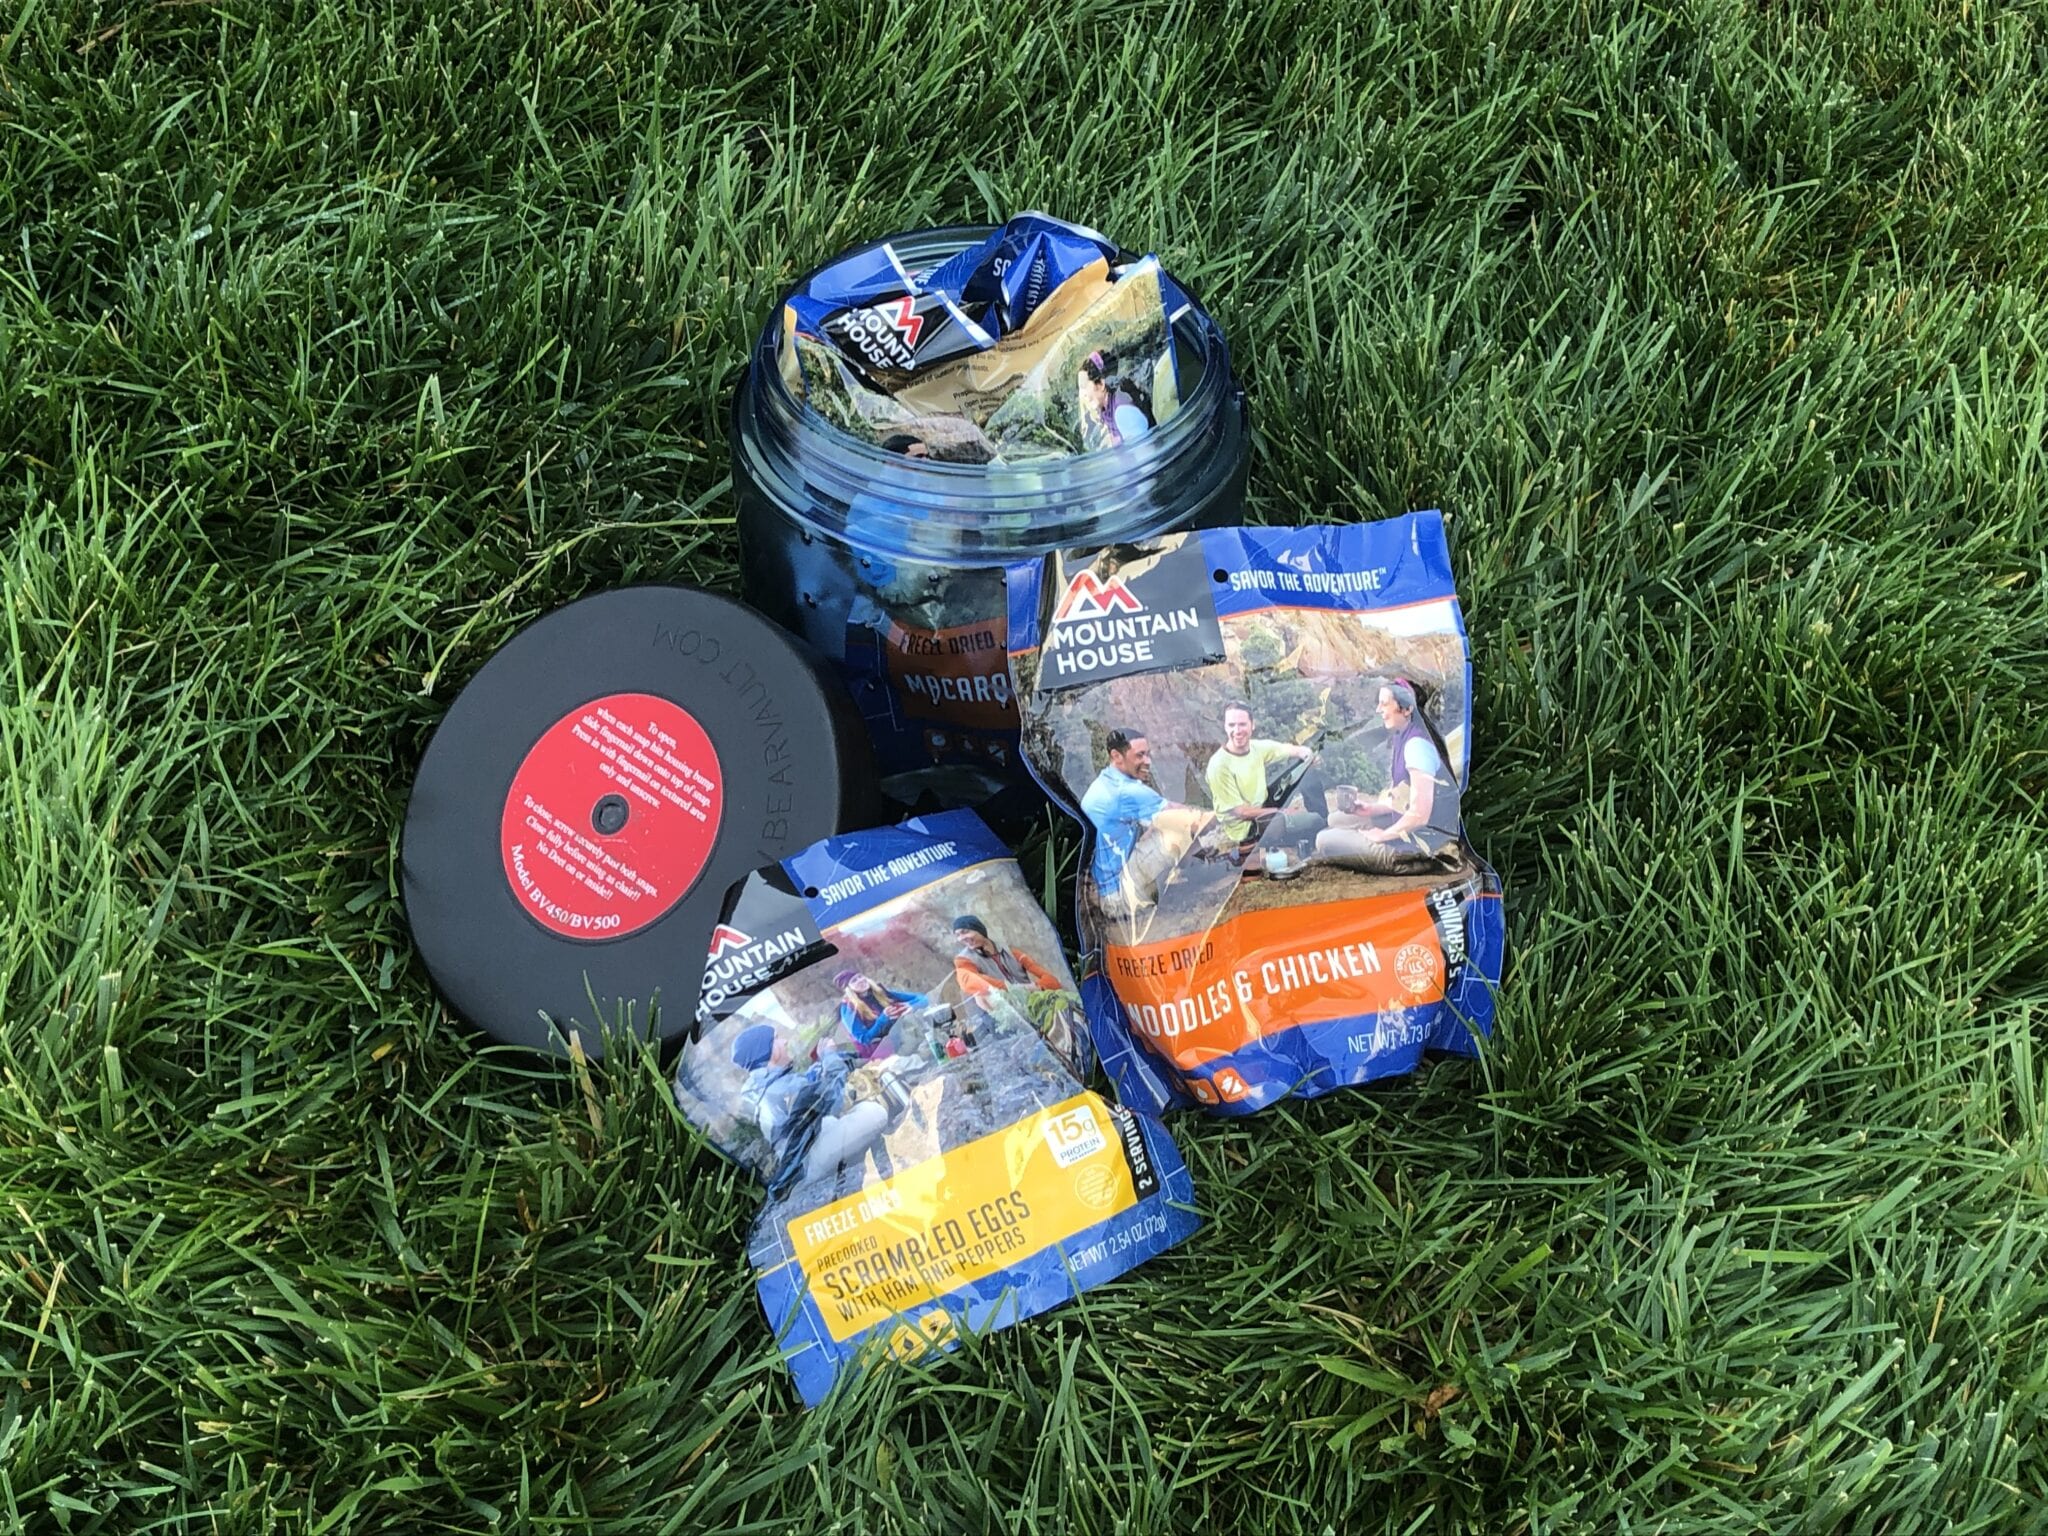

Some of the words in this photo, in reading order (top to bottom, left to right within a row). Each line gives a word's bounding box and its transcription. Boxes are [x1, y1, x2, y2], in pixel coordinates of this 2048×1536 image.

[838, 312, 893, 369] HOUSE
[851, 308, 916, 371] MOUNTA
[1231, 571, 1277, 592] SAVOR
[1277, 571, 1301, 592] THE
[948, 630, 995, 654] DRIED
[1052, 607, 1198, 649] MOUNTAIN
[1057, 642, 1153, 675] HOUSE
[904, 672, 1008, 704] MACARO
[597, 707, 617, 725] when
[615, 720, 634, 736] each
[632, 732, 651, 749] snap
[649, 740, 665, 758] hits
[663, 751, 694, 779] housing
[693, 770, 715, 792] bump
[647, 721, 659, 735] To
[572, 724, 592, 743] Press
[591, 737, 601, 749] in
[600, 744, 617, 760] with
[616, 755, 652, 783] fingernail
[650, 779, 661, 791] on
[660, 785, 692, 811] textured
[690, 806, 707, 822] area
[582, 715, 600, 731] slide
[599, 725, 635, 754] fingernail
[633, 749, 655, 768] down
[653, 764, 672, 780] onto
[670, 774, 684, 789] top
[683, 785, 696, 795] of
[599, 762, 616, 779] only
[615, 774, 632, 788] and
[524, 794, 534, 808] To
[553, 818, 576, 837] screw
[574, 832, 605, 859] securely
[603, 854, 621, 870] past
[620, 863, 637, 881] both
[526, 815, 547, 835] Close
[546, 827, 564, 848] fully
[563, 842, 587, 865] before
[585, 859, 607, 881] using
[605, 875, 616, 885] as
[536, 840, 549, 855] No
[548, 849, 567, 869] Deet
[565, 863, 577, 875] on
[575, 870, 586, 881] or
[511, 843, 535, 891] Model
[529, 887, 621, 931] BV450/BV500
[820, 876, 864, 906] SAVOR
[863, 865, 890, 889] THE
[1432, 889, 1465, 963] SERVINGS
[700, 927, 806, 990] OUNTAIN
[1117, 953, 1165, 977] FREEZE
[695, 964, 772, 1022] HOUSE
[1127, 980, 1231, 1037] NOODLES
[1233, 971, 1253, 1002] &
[1261, 941, 1381, 994] CHICKEN
[1348, 1033, 1375, 1053] NET
[1400, 1024, 1423, 1045] 4.73
[1049, 1113, 1097, 1146] 15g
[1060, 1136, 1100, 1161] PROTEIN
[1114, 1104, 1148, 1174] SERVINGS
[1138, 1176, 1153, 1190] 2
[803, 1207, 858, 1246] FREEZE
[823, 1219, 966, 1300] SCRAMBLED
[967, 1190, 1030, 1239] EGGS
[1085, 1243, 1107, 1264] WT
[1109, 1235, 1131, 1255] 2.54
[1145, 1213, 1167, 1239] (72g)
[816, 1235, 877, 1272] PRECOOKED
[836, 1290, 881, 1322] WITH
[884, 1275, 920, 1303] HAM
[921, 1259, 955, 1286] AND
[959, 1226, 1027, 1271] PEPPERS
